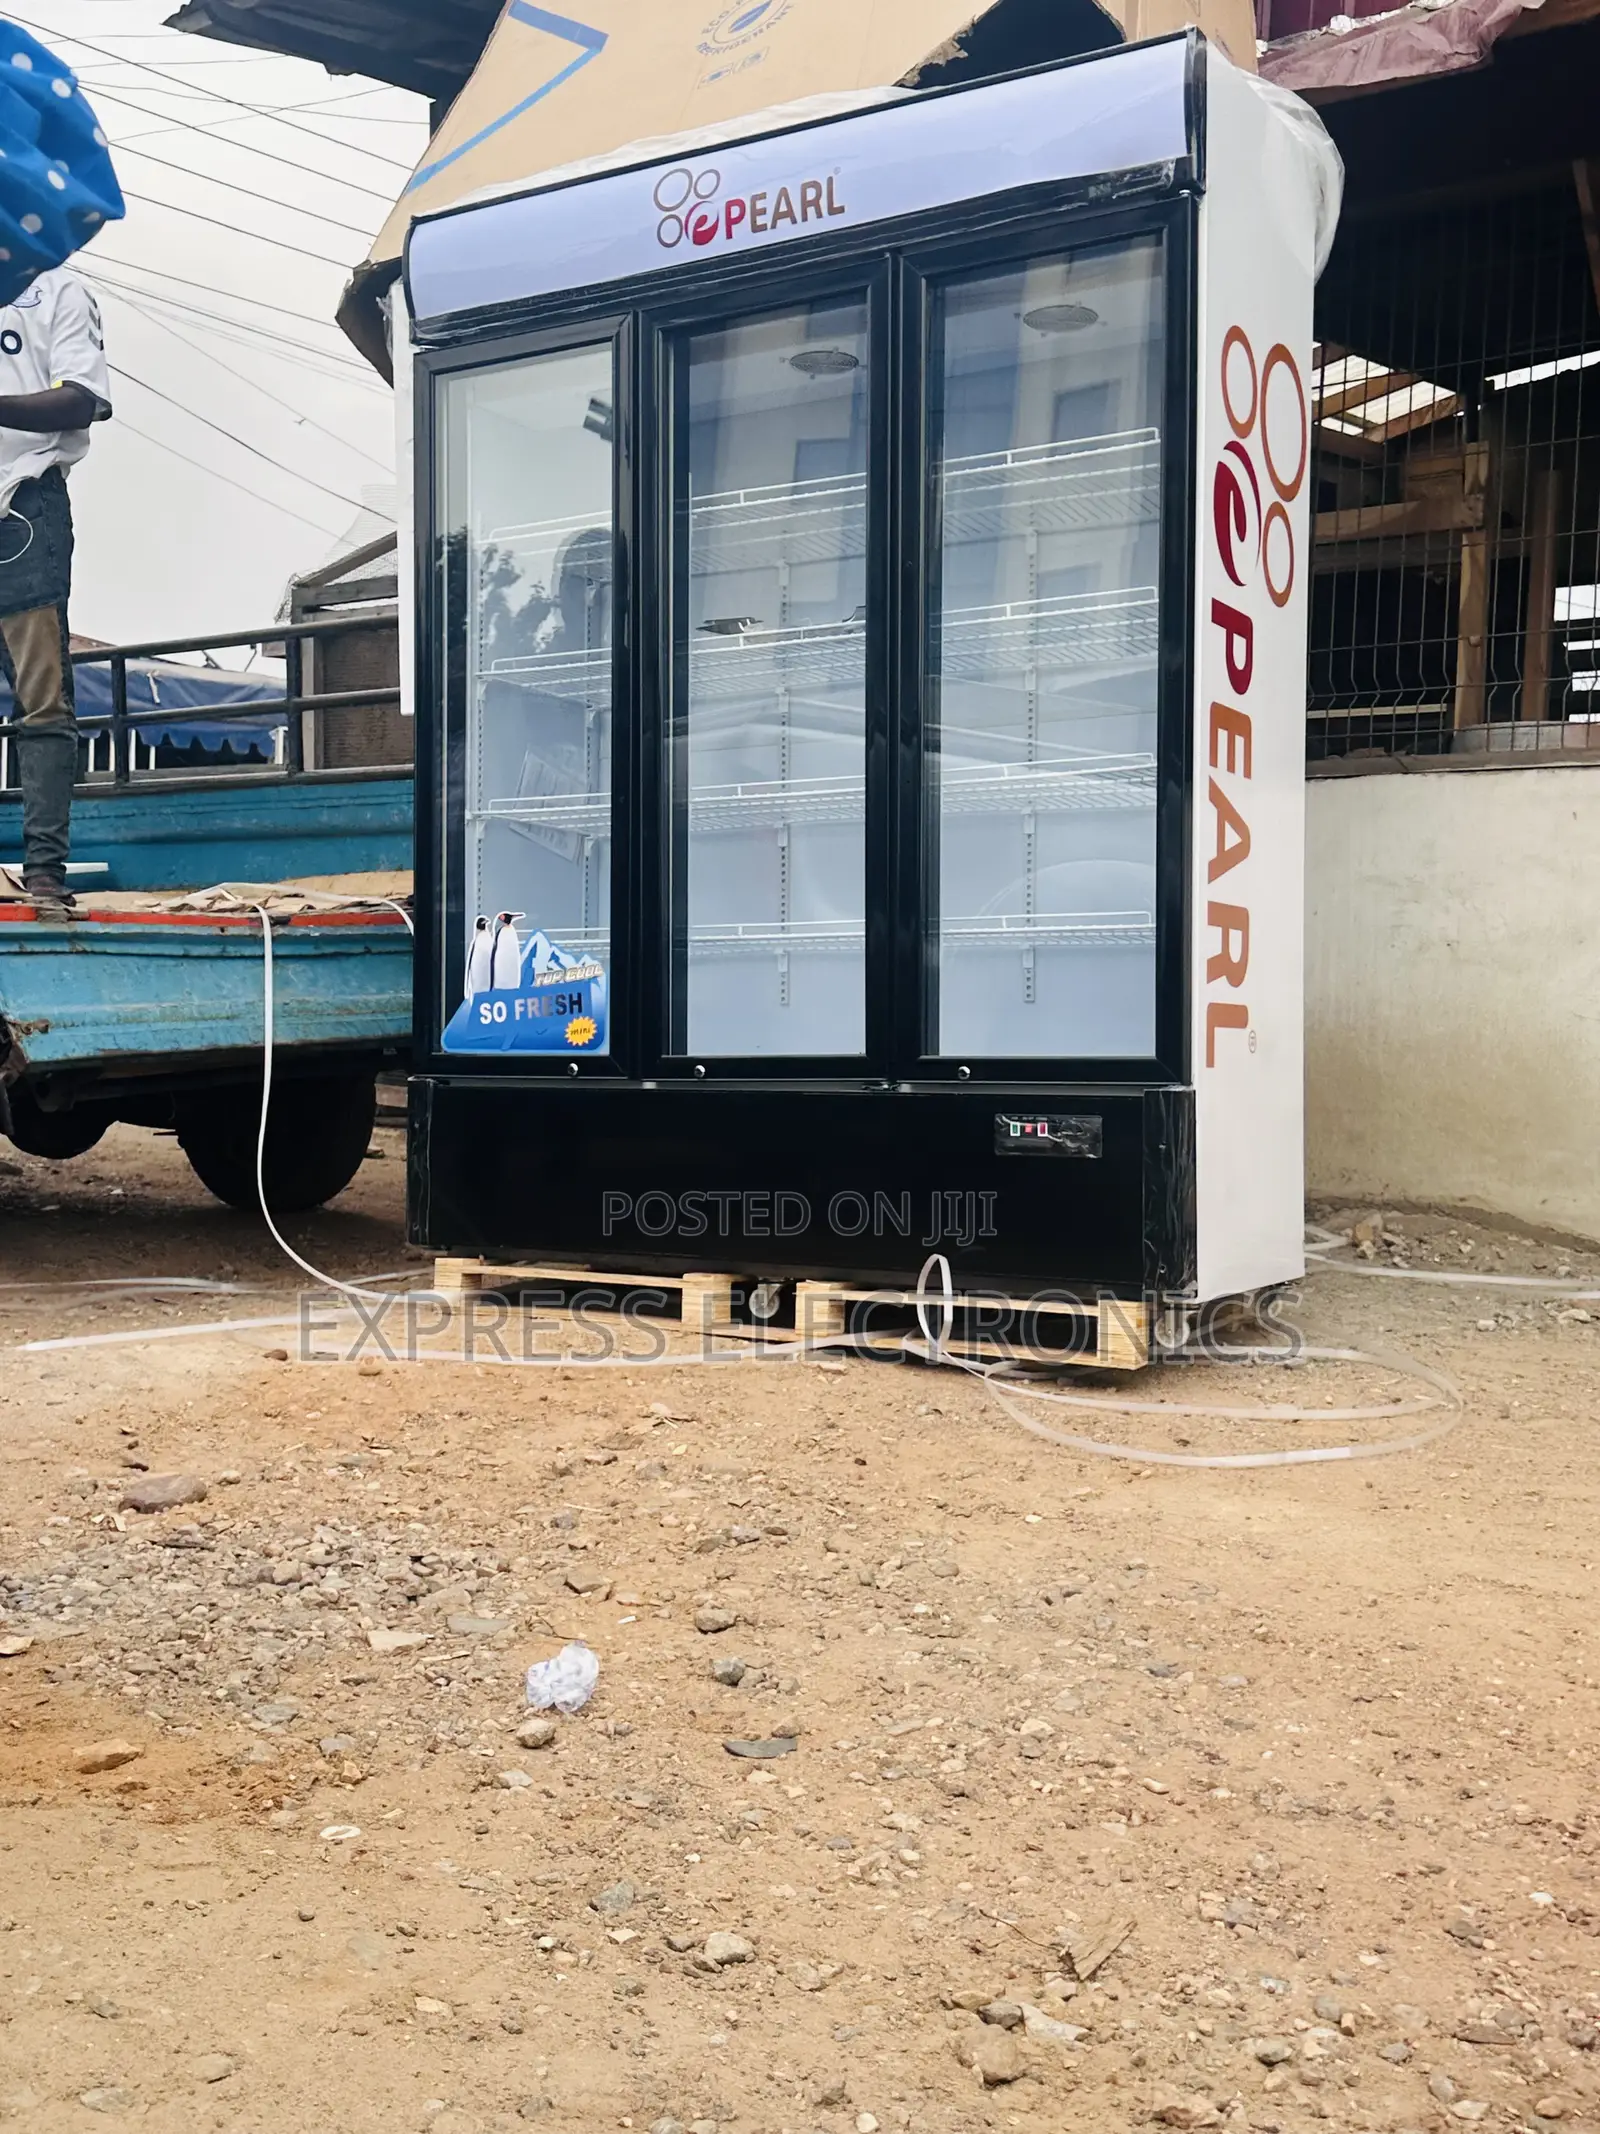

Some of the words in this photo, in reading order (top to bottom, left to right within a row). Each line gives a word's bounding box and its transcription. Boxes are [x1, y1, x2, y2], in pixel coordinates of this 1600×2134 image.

[725, 176, 845, 240] PEARL
[1206, 597, 1253, 1068] PEARL
[534, 970, 565, 988] TOP
[564, 964, 604, 982] COOL
[480, 1001, 507, 1025] SO
[514, 992, 583, 1020] FRESH
